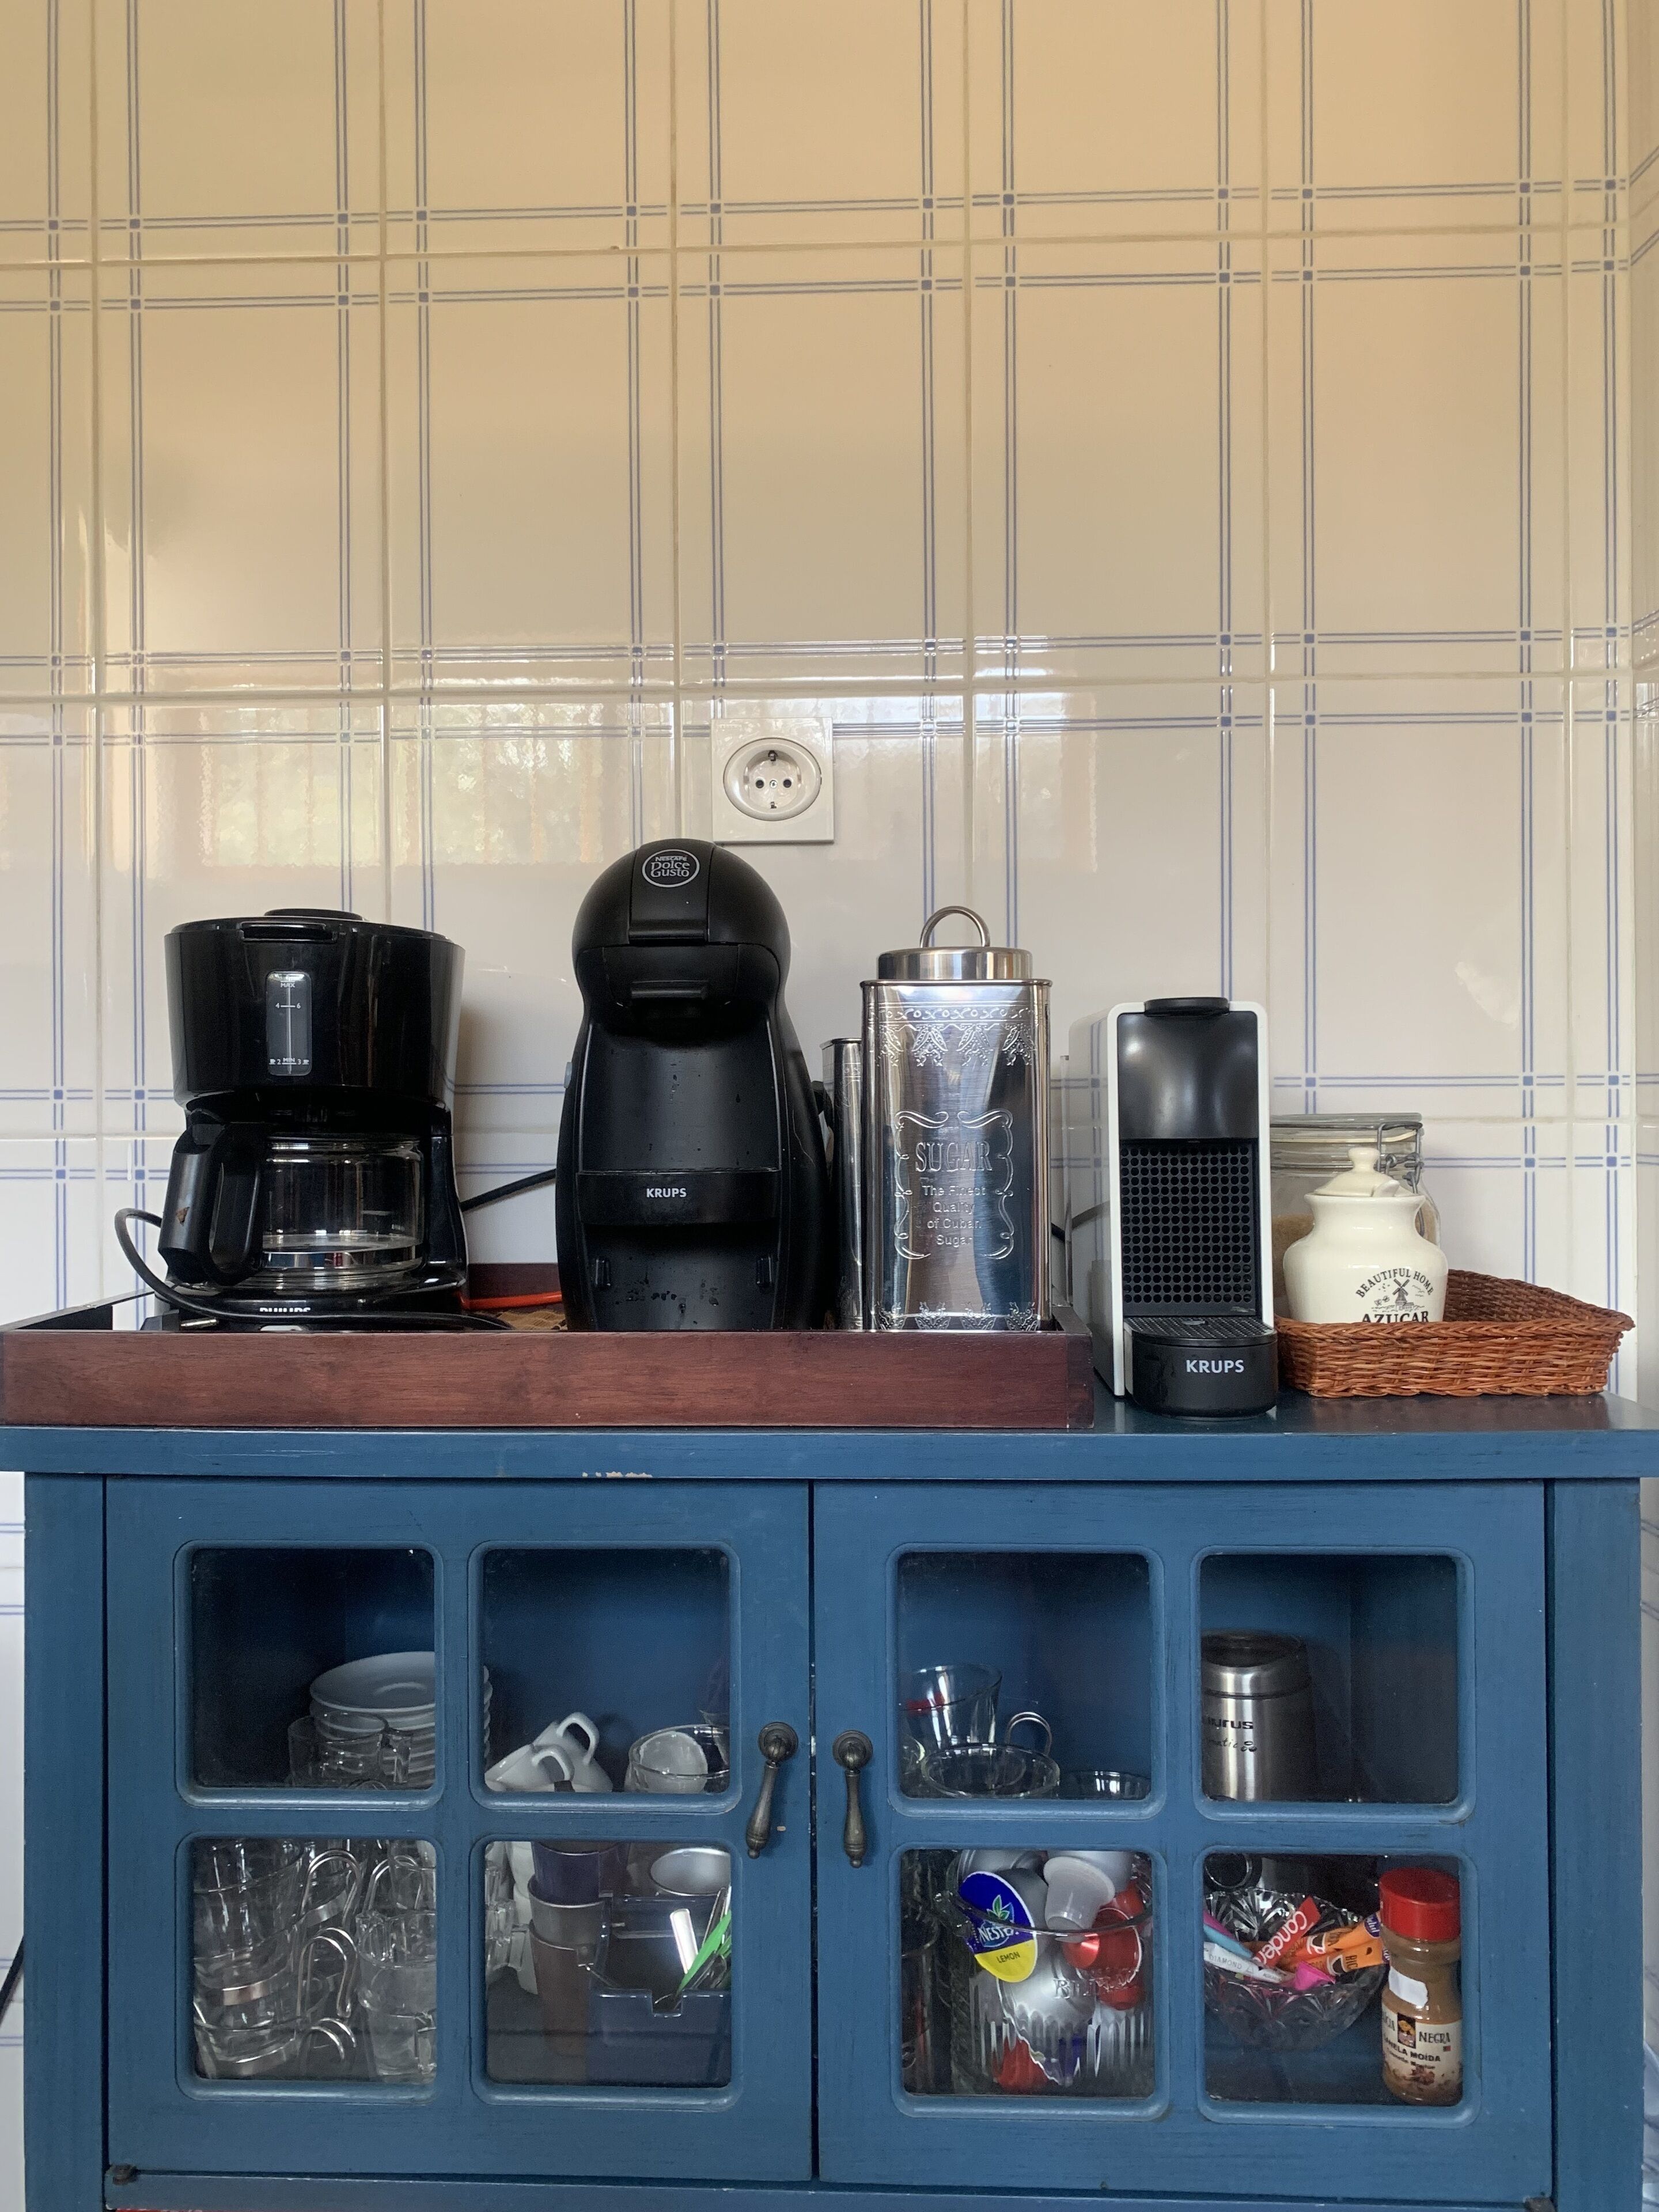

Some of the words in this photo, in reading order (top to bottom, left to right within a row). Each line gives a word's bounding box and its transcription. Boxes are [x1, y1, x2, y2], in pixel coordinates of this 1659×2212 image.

[650, 861, 690, 870] Dolce
[650, 869, 690, 877] Gusto
[915, 1141, 993, 1172] SUGAR
[646, 1188, 687, 1198] KRUPS
[922, 1185, 945, 1195] The
[949, 1185, 986, 1195] Finest
[933, 1202, 975, 1215] Quality
[927, 1218, 940, 1229] of
[943, 1218, 982, 1229] Cuban
[936, 1234, 973, 1248] Sugar
[1355, 1268, 1411, 1298] BEAUTIFUL
[1413, 1271, 1434, 1296] HOME
[1186, 1359, 1244, 1373] KRUPS
[996, 1952, 1021, 1963] LEMON
[1209, 1955, 1243, 1970] DIAMOND
